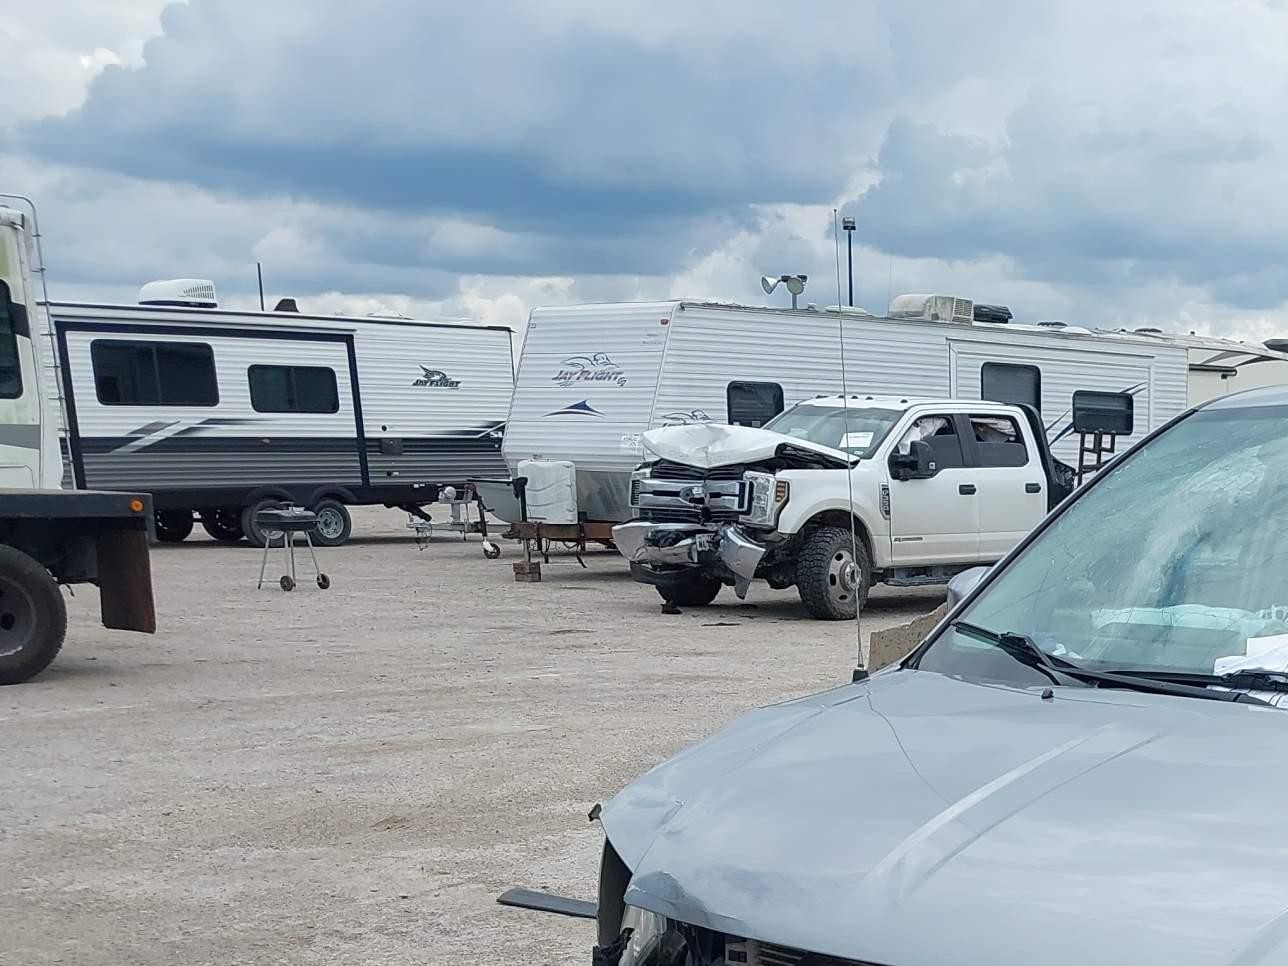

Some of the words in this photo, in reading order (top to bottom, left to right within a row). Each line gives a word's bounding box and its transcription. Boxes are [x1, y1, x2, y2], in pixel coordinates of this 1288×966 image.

[552, 370, 579, 381] JAY
[576, 370, 624, 381] FLIGHT
[411, 378, 429, 387] JAY
[429, 379, 462, 388] FLIGHT
